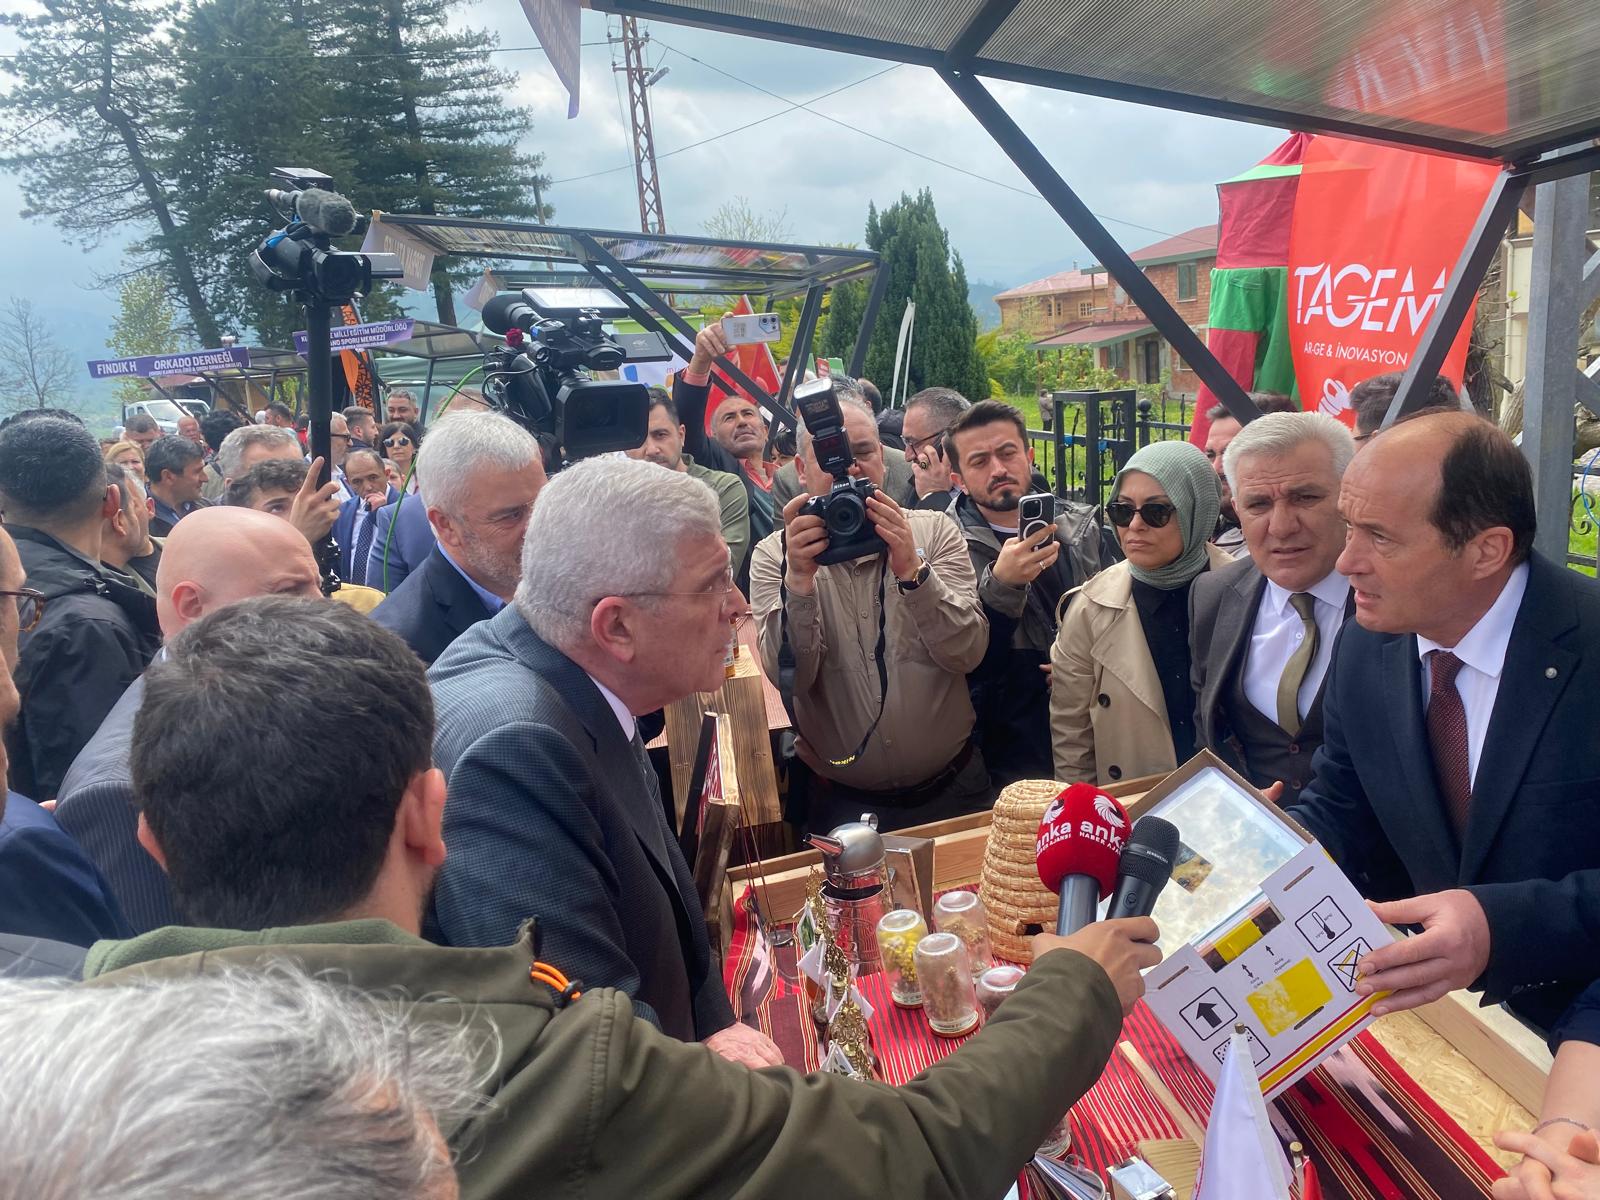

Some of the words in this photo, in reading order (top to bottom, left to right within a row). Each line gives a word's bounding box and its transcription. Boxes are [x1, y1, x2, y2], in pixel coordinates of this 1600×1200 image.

[1294, 262, 1446, 336] TAGEM
[153, 356, 192, 370] ORKADO
[193, 351, 234, 366] DERNEĞİ
[1304, 342, 1325, 356] AR-GE
[1326, 345, 1333, 356] &
[1335, 341, 1409, 366] İNOVASYON
[96, 362, 128, 375] FINDIK
[833, 482, 849, 490] Nikon
[1079, 831, 1106, 846] HABER
